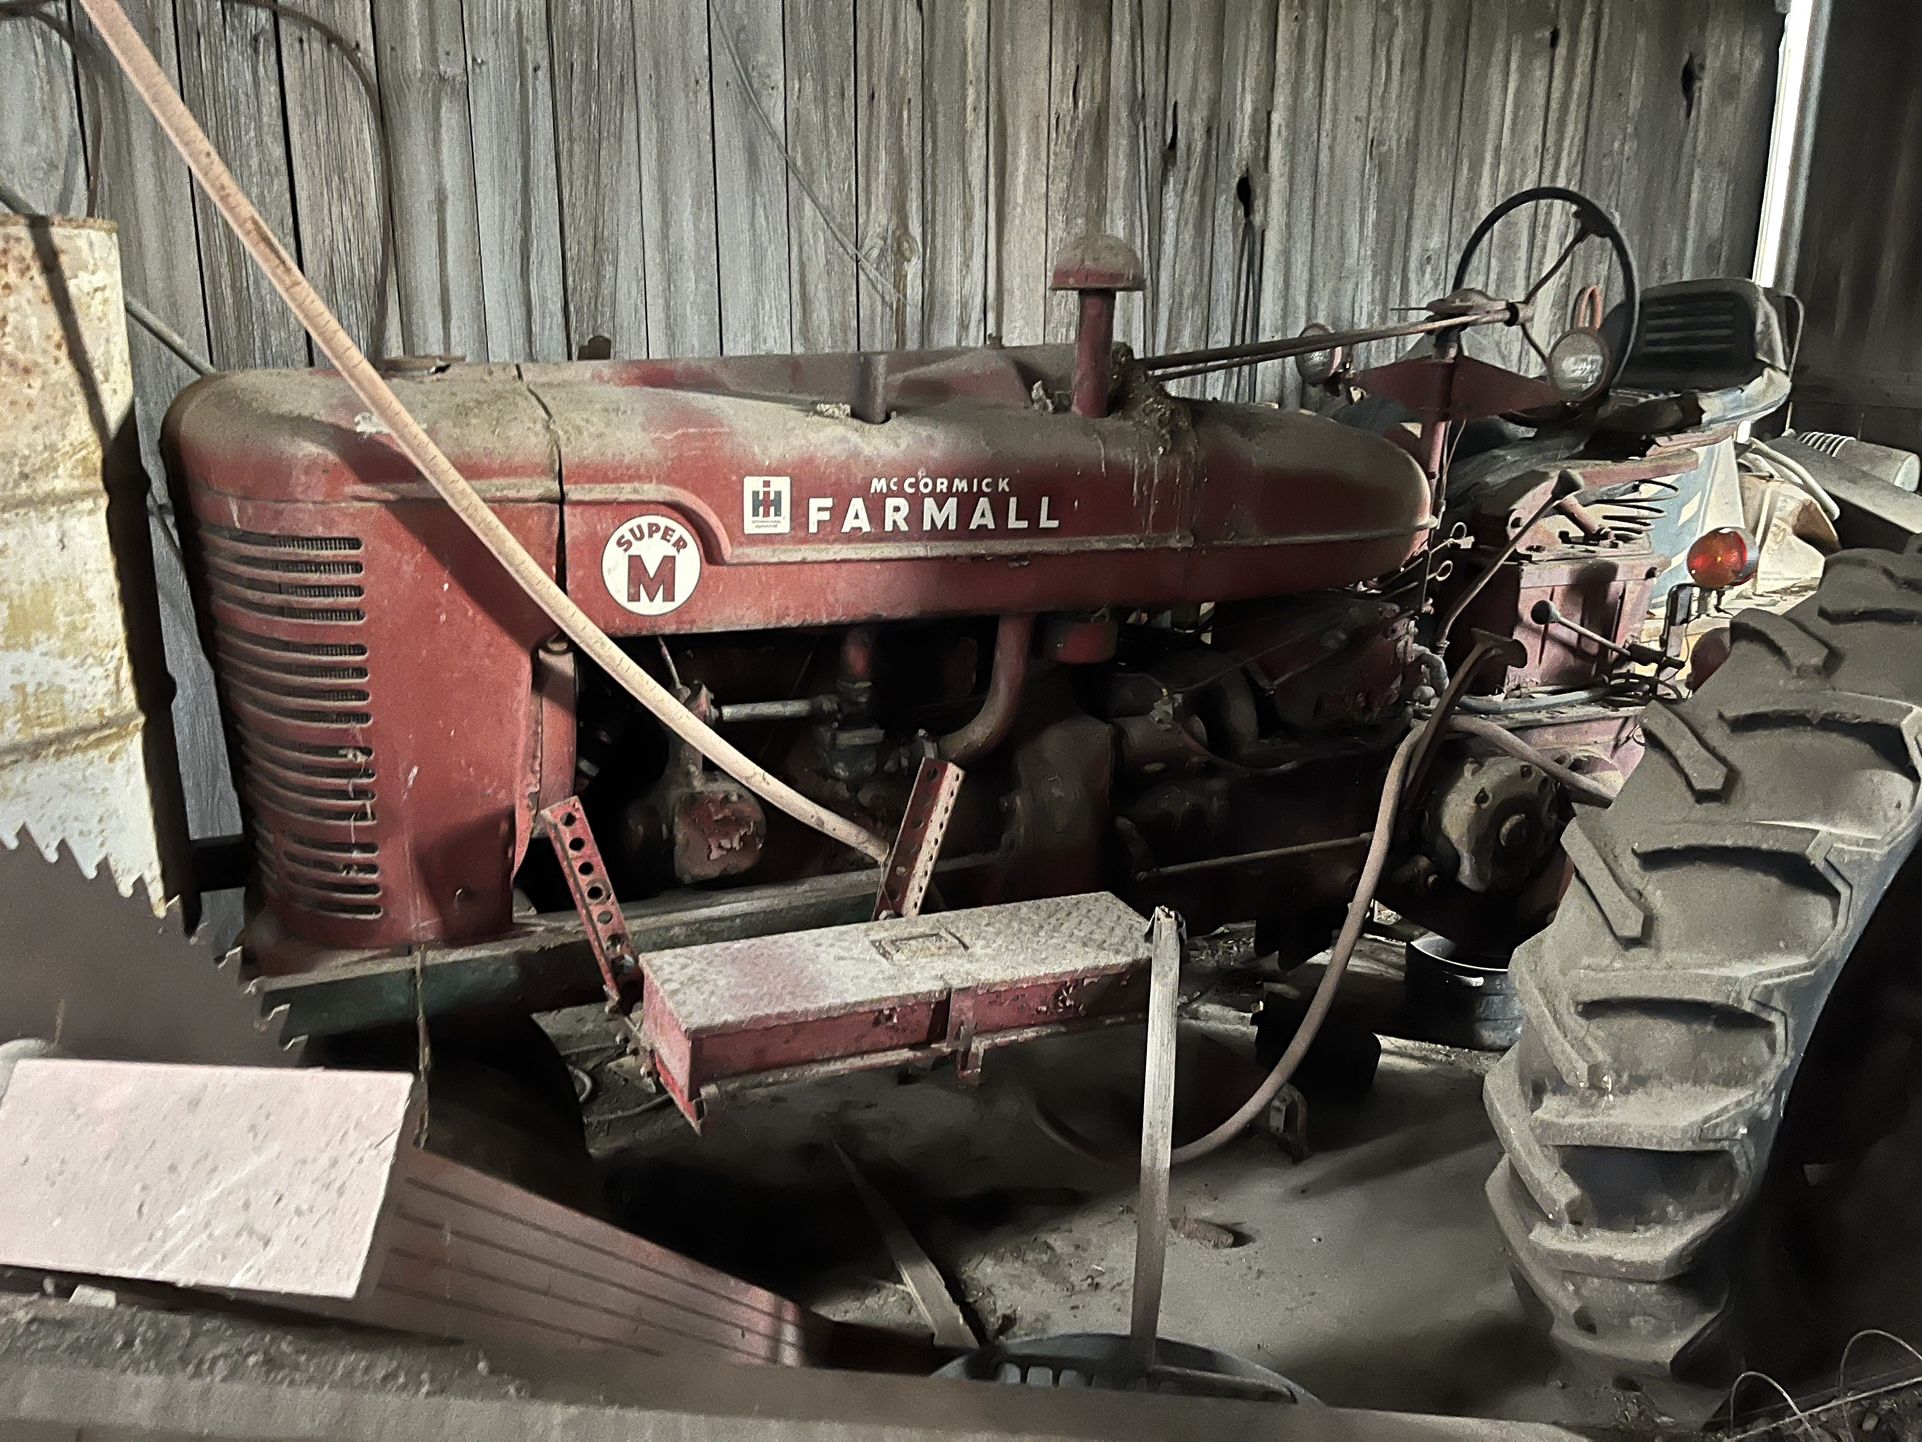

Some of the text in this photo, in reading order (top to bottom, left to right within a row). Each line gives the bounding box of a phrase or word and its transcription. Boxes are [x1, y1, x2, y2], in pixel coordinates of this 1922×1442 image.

[808, 496, 1059, 534] FARMALL
[616, 522, 688, 554] SUPER
[627, 554, 676, 602] M
